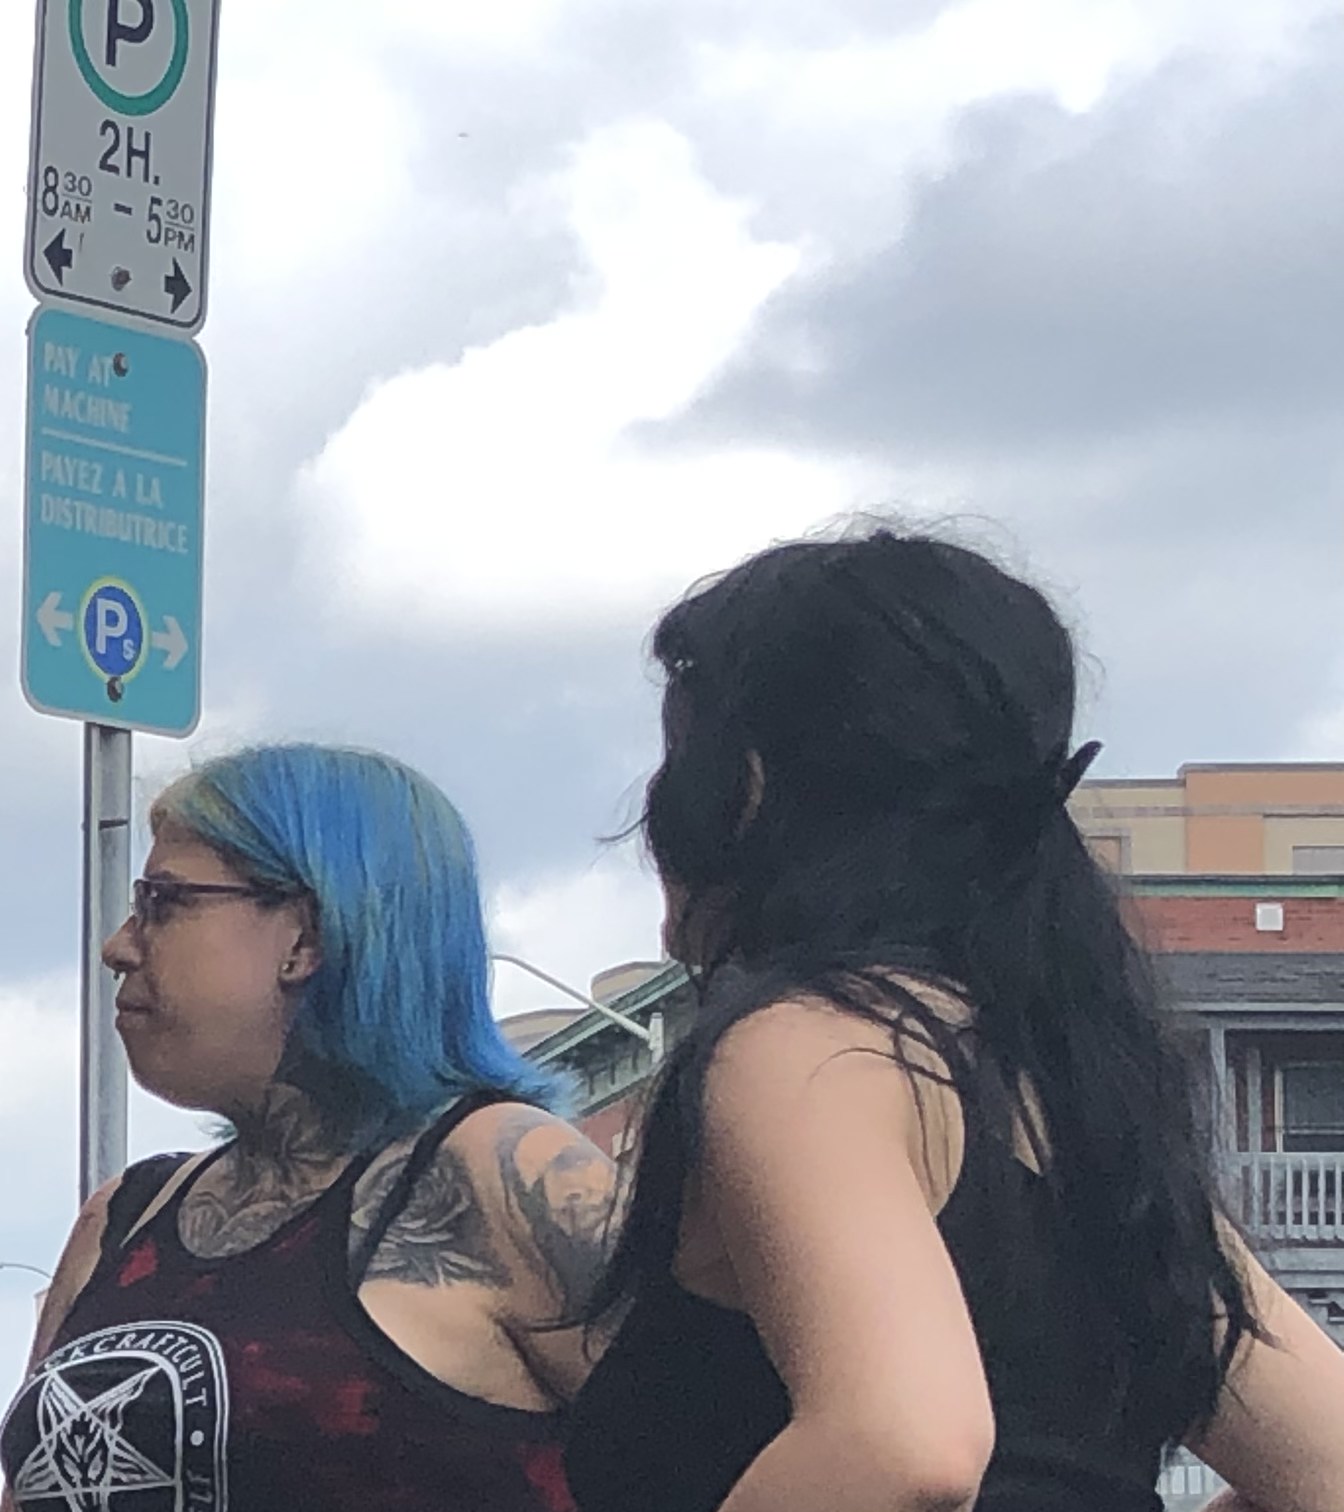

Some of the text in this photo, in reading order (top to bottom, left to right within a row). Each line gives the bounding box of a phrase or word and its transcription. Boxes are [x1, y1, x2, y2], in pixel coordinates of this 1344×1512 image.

[164, 226, 195, 253] PM
[43, 342, 113, 387] PAY AT
[43, 383, 132, 433] MACHINE
[41, 450, 163, 509] PAYEZ A LA
[41, 493, 188, 555] DISTRIBUTRICE
